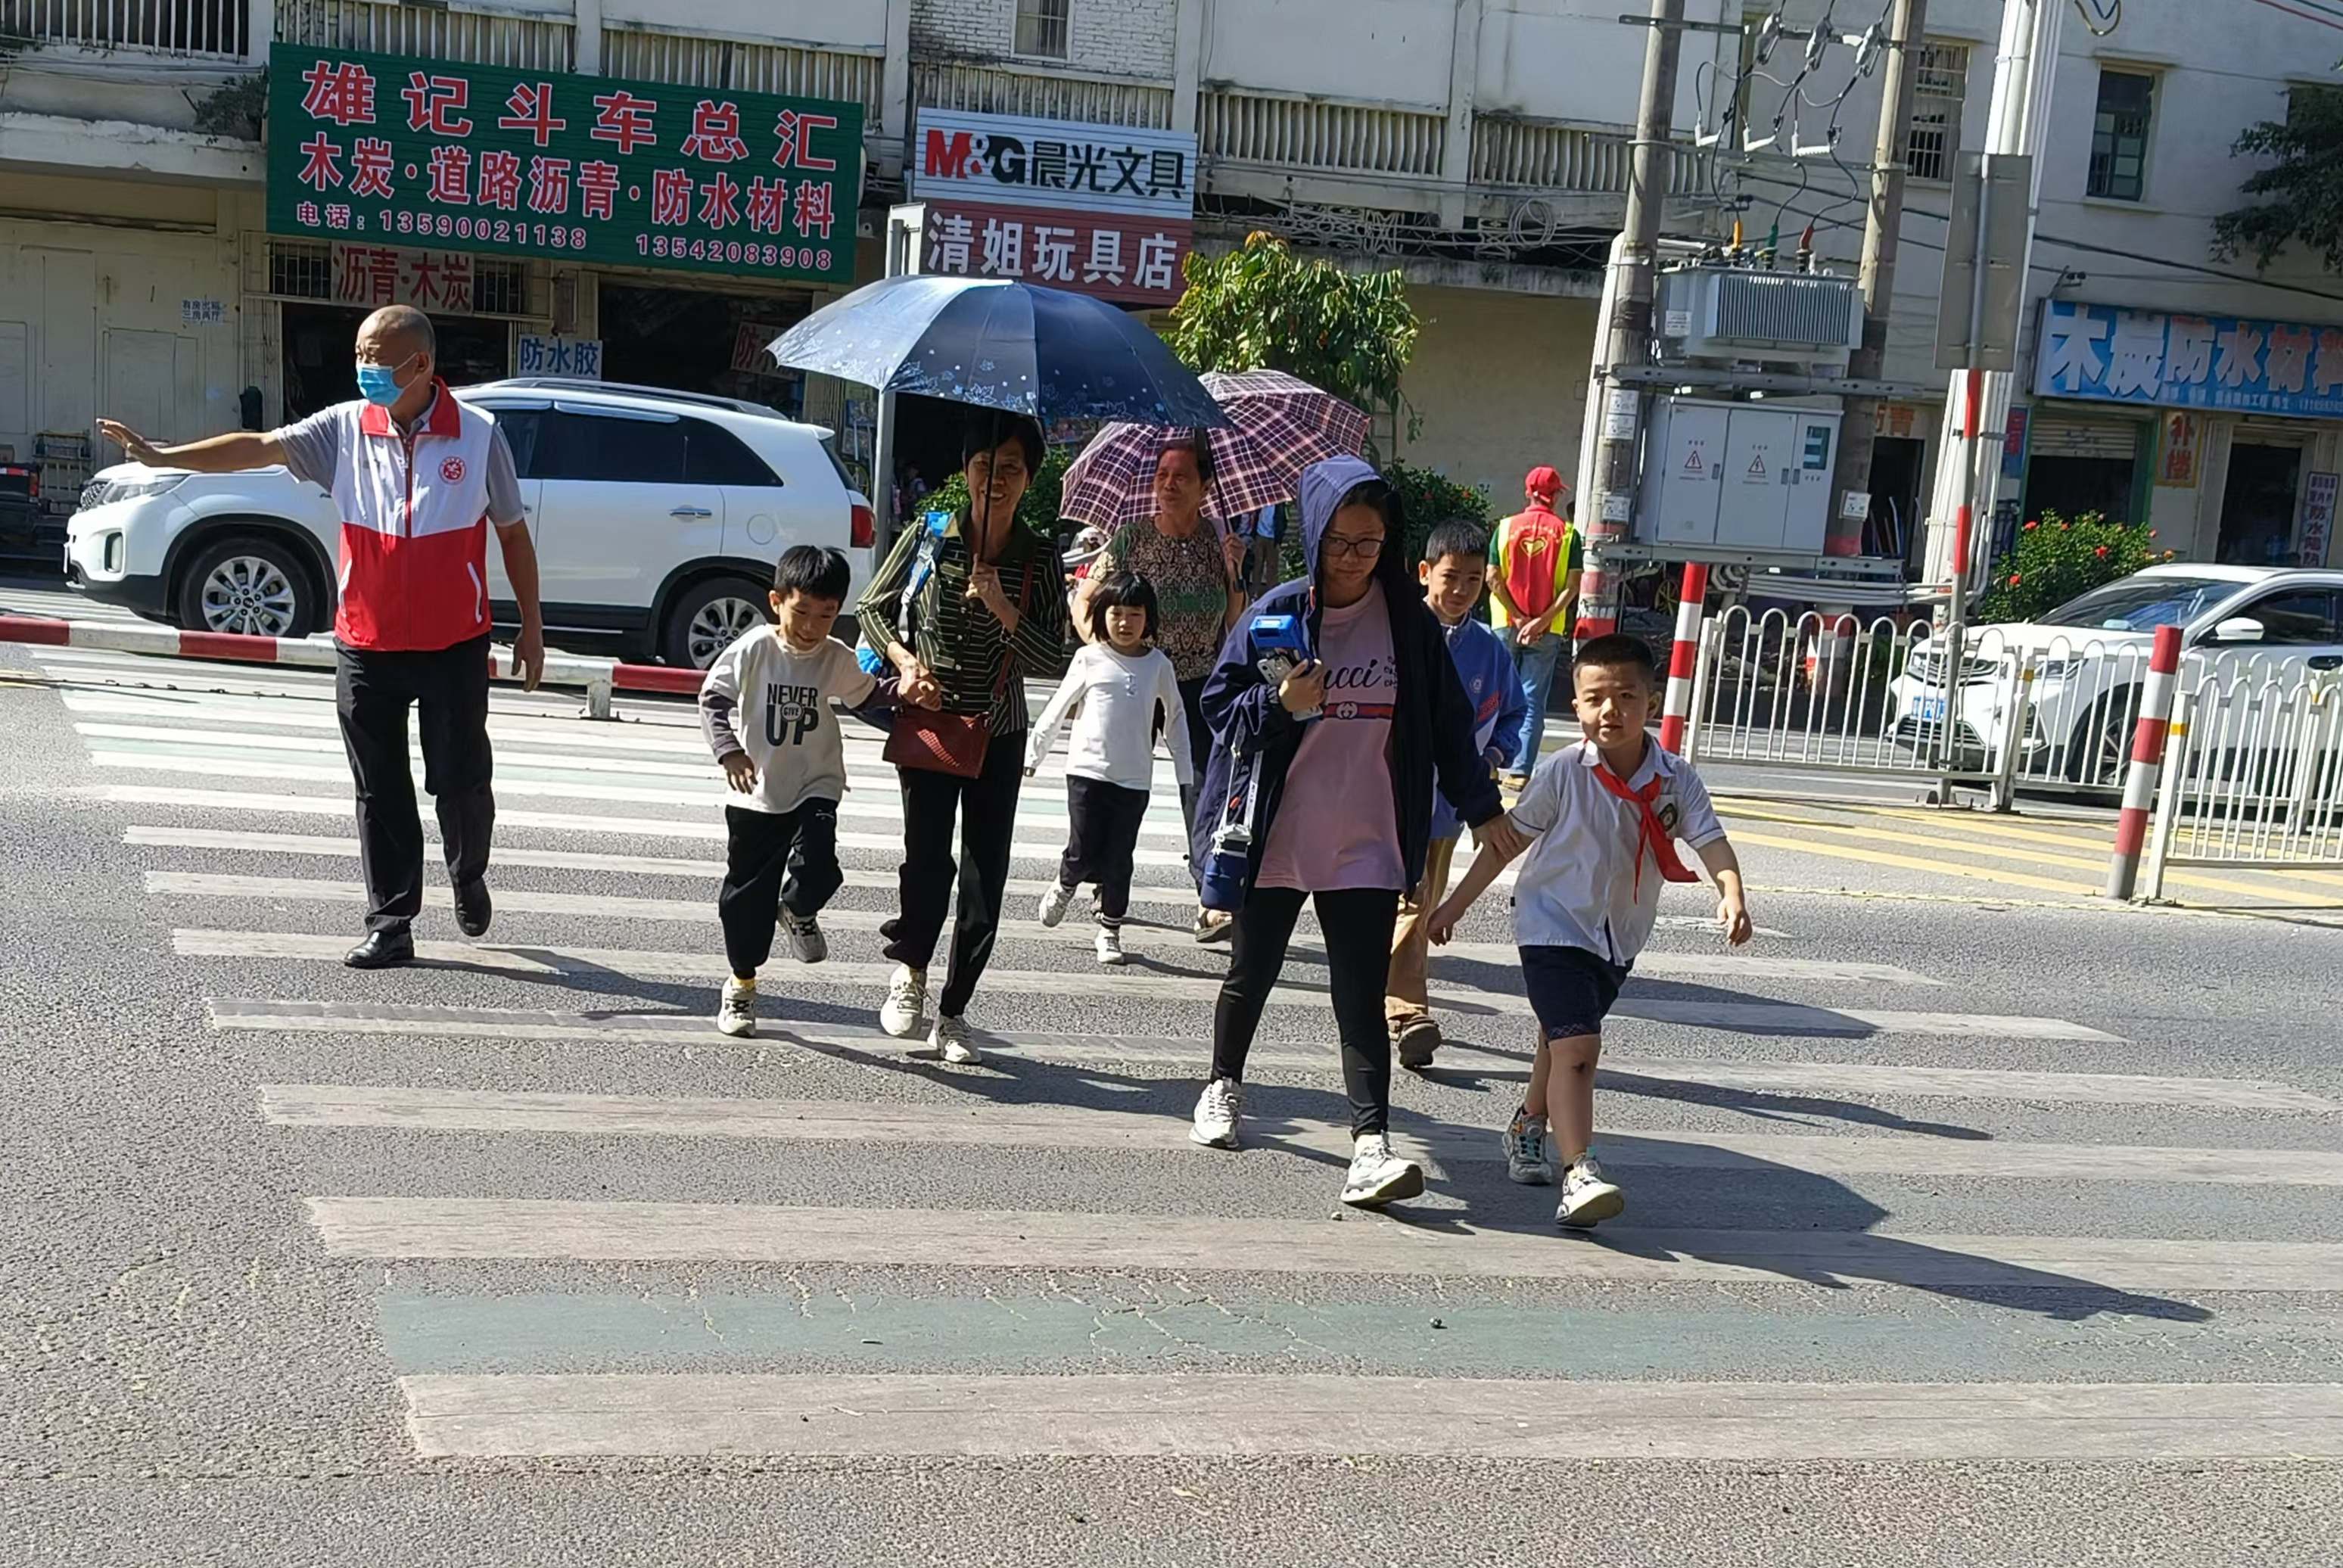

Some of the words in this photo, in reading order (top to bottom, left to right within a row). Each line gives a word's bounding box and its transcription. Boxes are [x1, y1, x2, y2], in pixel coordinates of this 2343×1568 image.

[302, 61, 838, 171] 雄记斗车总汇
[298, 131, 835, 240] 木炭·道路沥青·防水材料
[1031, 140, 1187, 199] 晨光文具
[636, 233, 832, 271] 13542083908
[927, 211, 1177, 290] 清姐玩具店
[520, 338, 598, 375] 防水胶
[767, 683, 818, 708] NEVER
[783, 707, 800, 716] GIVE
[766, 704, 819, 746] UP
